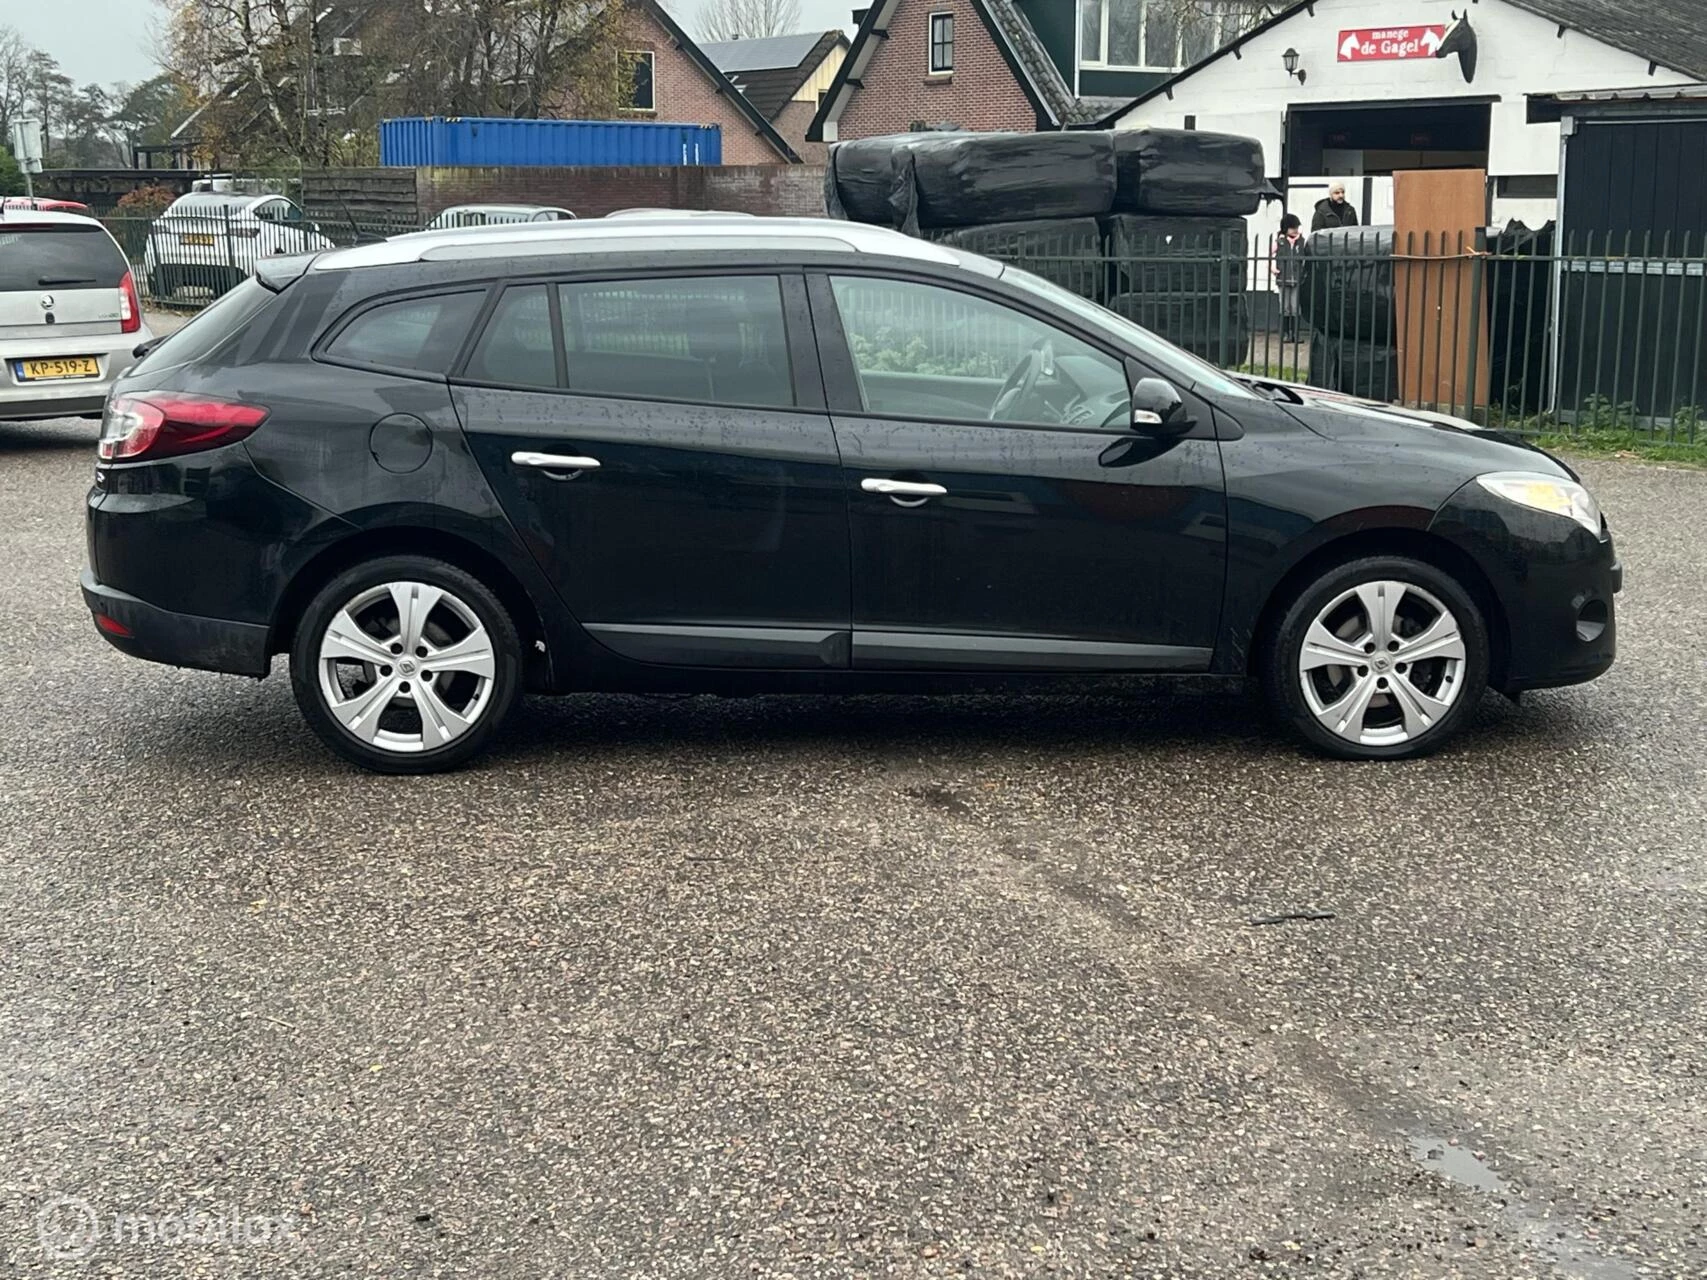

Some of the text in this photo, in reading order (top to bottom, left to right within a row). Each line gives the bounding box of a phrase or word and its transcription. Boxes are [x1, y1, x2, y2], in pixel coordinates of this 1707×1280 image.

[1372, 29, 1409, 41] manege
[1360, 39, 1419, 57] de Gagel
[29, 359, 92, 375] KP-519-Z
